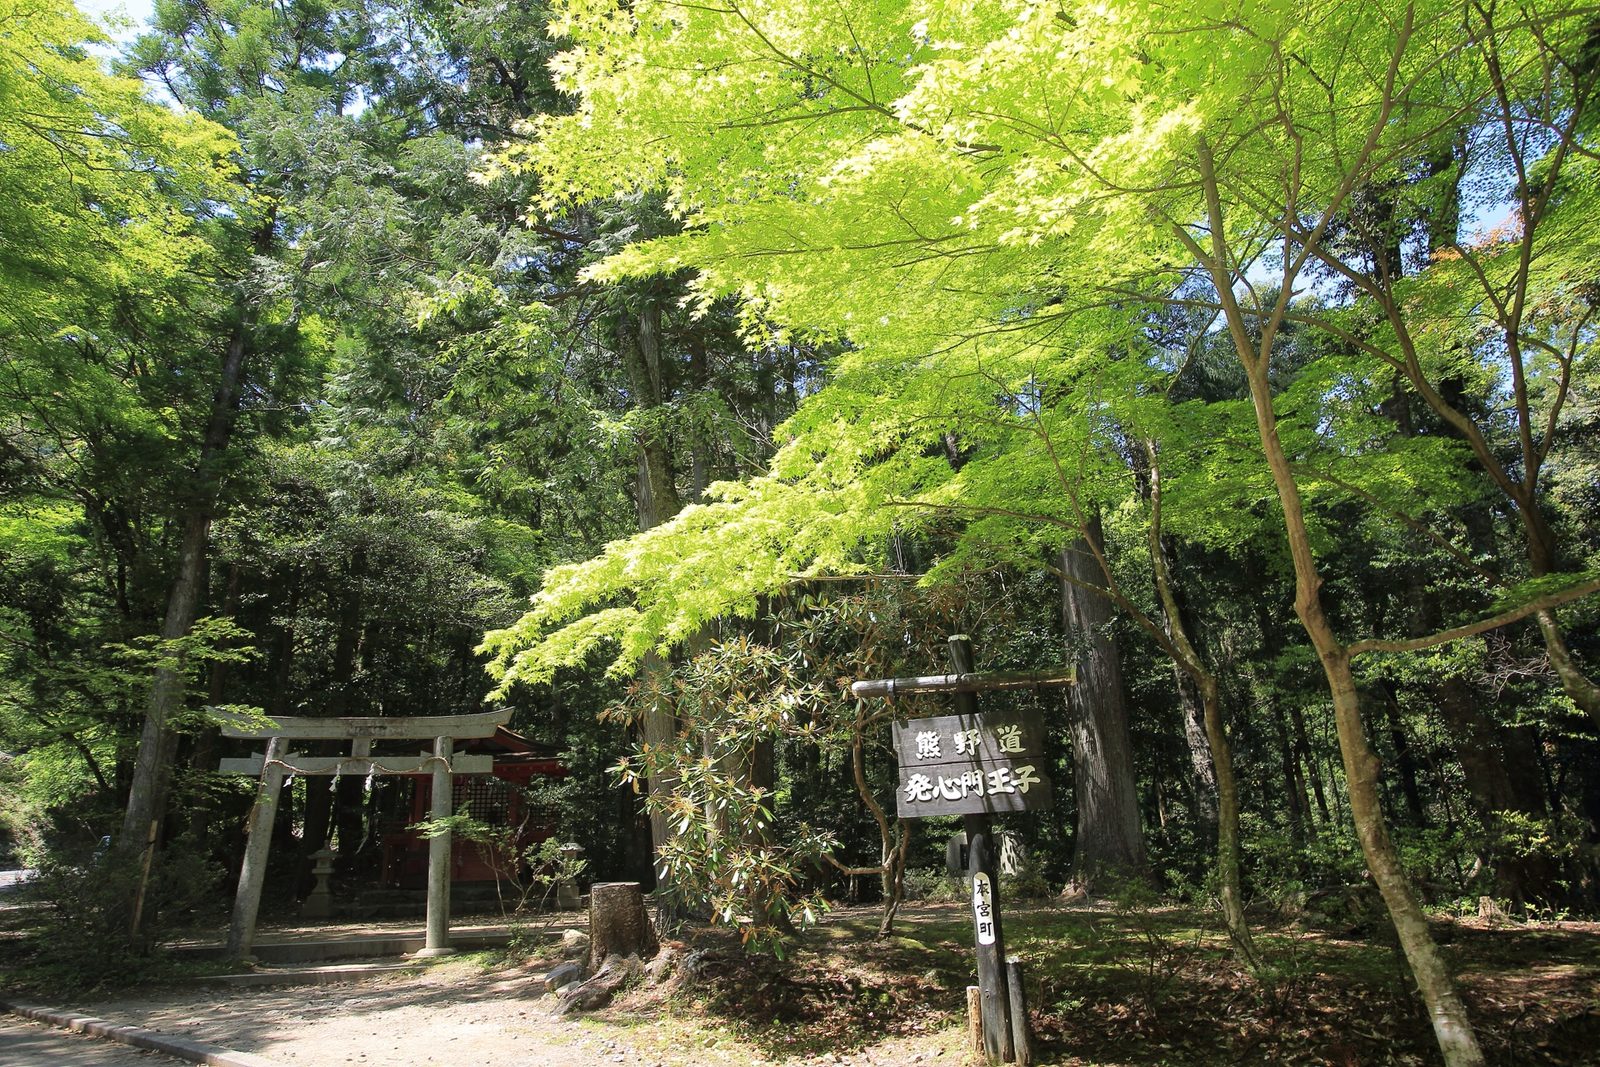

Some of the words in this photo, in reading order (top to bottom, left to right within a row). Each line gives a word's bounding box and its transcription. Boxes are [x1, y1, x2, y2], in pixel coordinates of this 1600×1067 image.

[915, 724, 1026, 760] 熊野道
[904, 765, 1041, 802] 発心門王子
[976, 879, 992, 937] 本宮町
